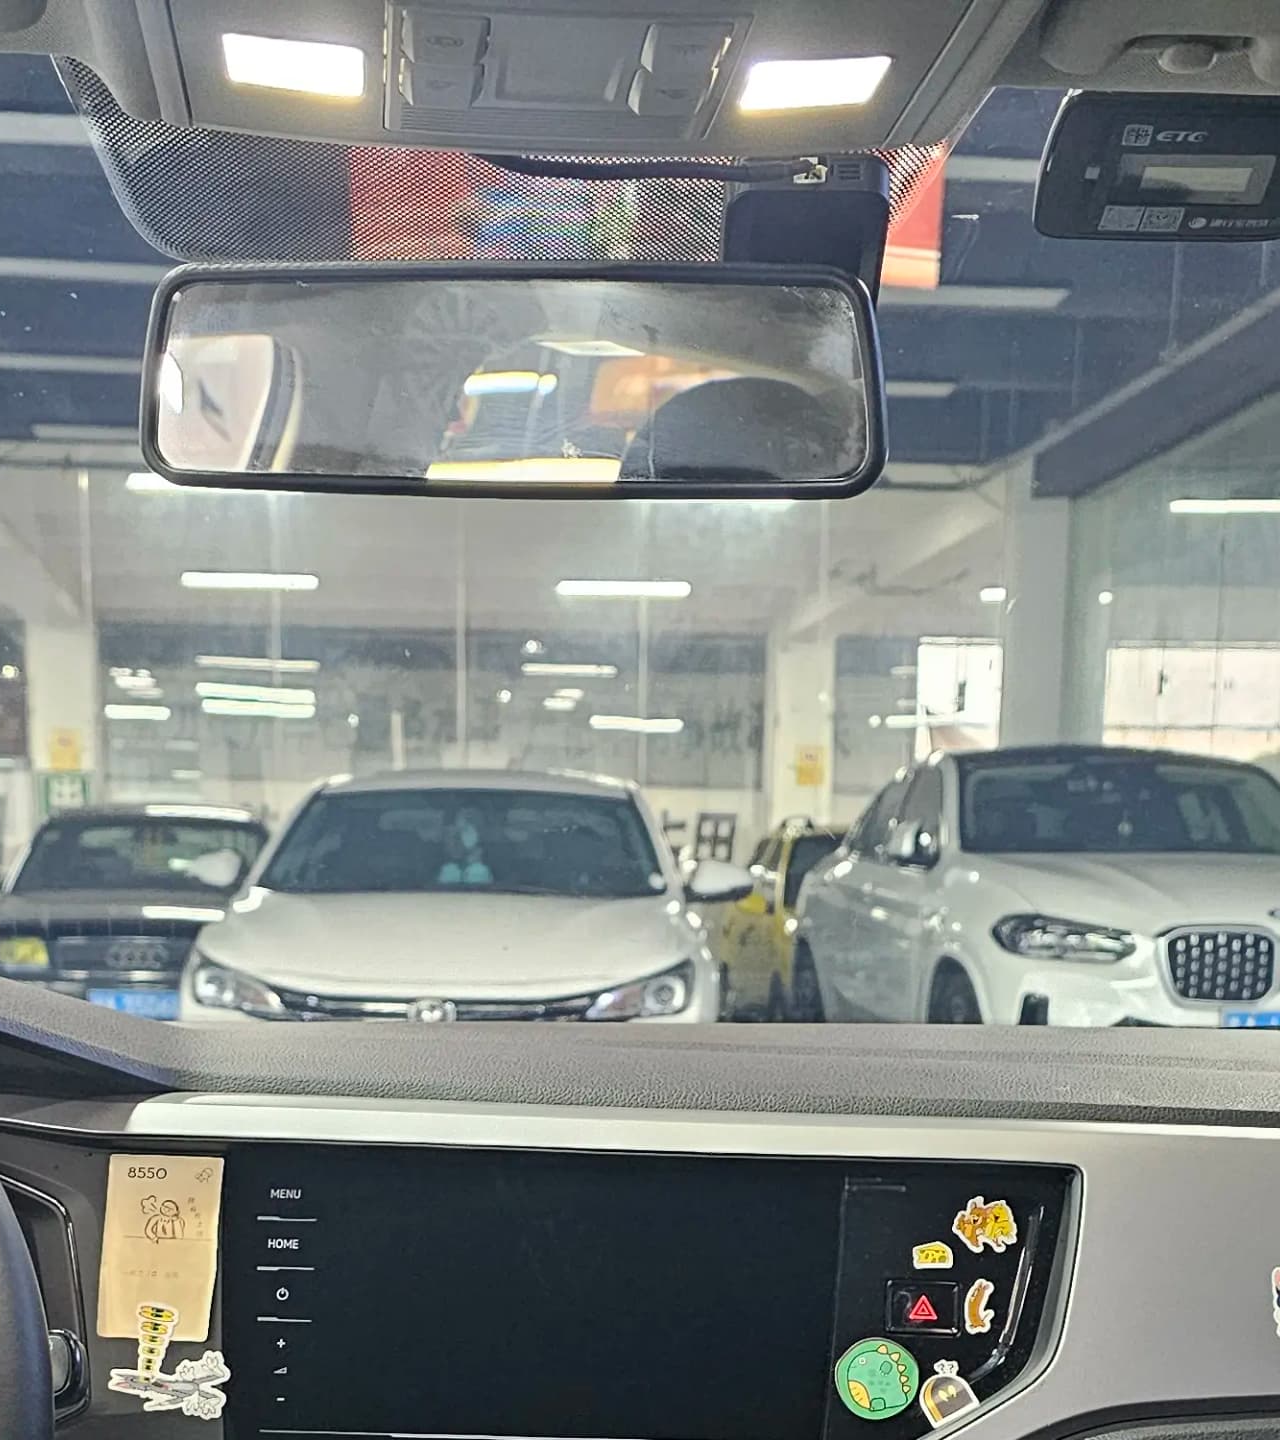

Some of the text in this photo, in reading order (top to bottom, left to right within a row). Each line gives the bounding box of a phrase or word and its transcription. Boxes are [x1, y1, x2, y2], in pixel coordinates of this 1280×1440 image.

[1156, 131, 1209, 143] ETC
[127, 1166, 168, 1180] 8550
[270, 1188, 302, 1200] MENU
[267, 1238, 299, 1250] HOME
